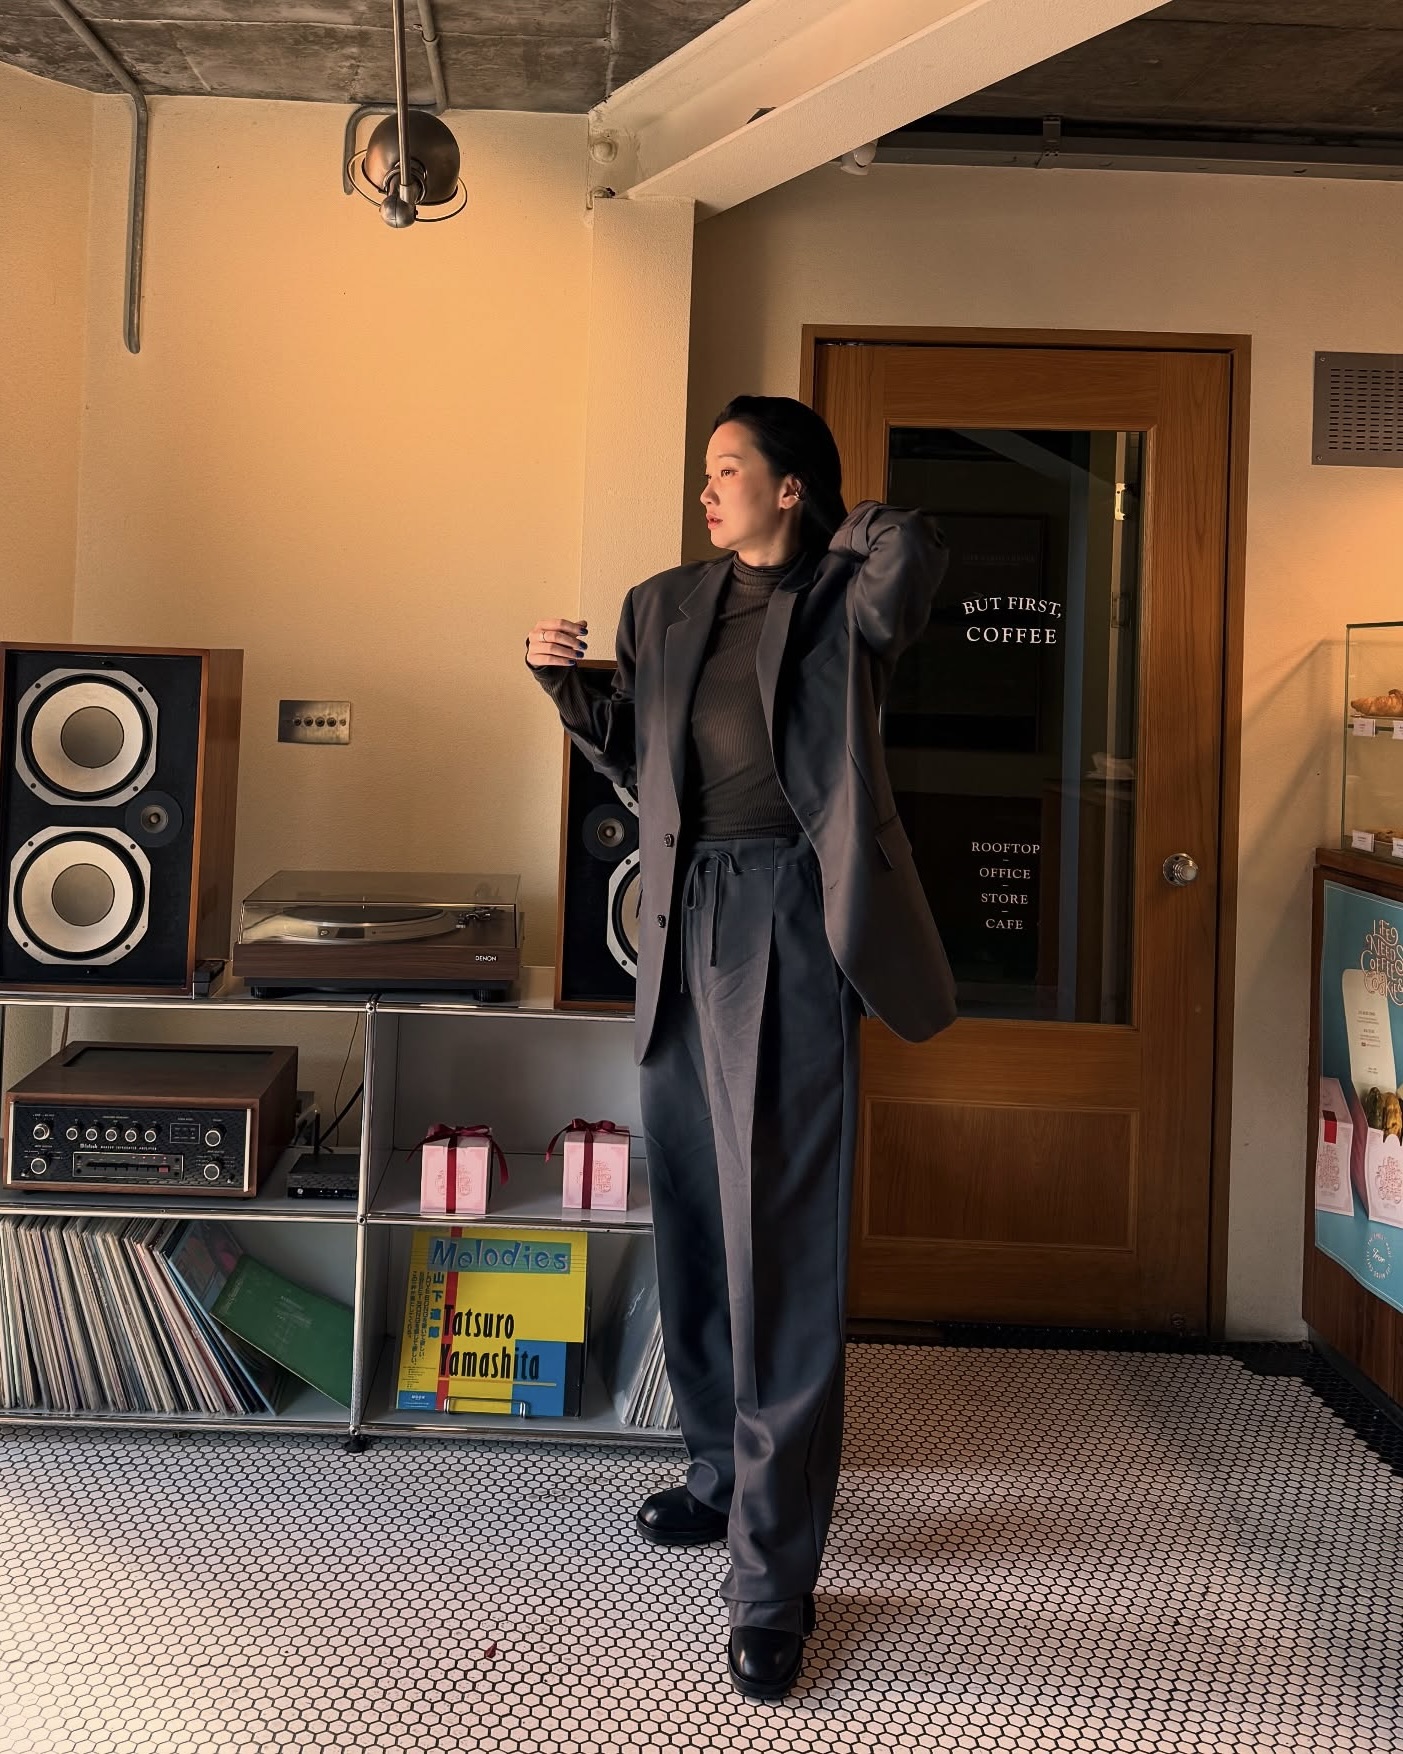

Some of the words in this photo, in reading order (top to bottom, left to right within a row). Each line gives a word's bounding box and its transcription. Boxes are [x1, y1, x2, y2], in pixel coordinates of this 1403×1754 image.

[961, 597, 1002, 615] BUT
[1007, 596, 1061, 619] FIRST,
[966, 626, 1057, 644] COFFEE
[971, 841, 1041, 854] ROOFTOP
[979, 867, 1031, 879] OFFICE
[980, 892, 1029, 905] STORE
[985, 918, 1024, 930] CAFE
[432, 1239, 569, 1272] Melodies
[444, 1304, 515, 1339] Tatsuro
[440, 1344, 540, 1380] Yamashita
